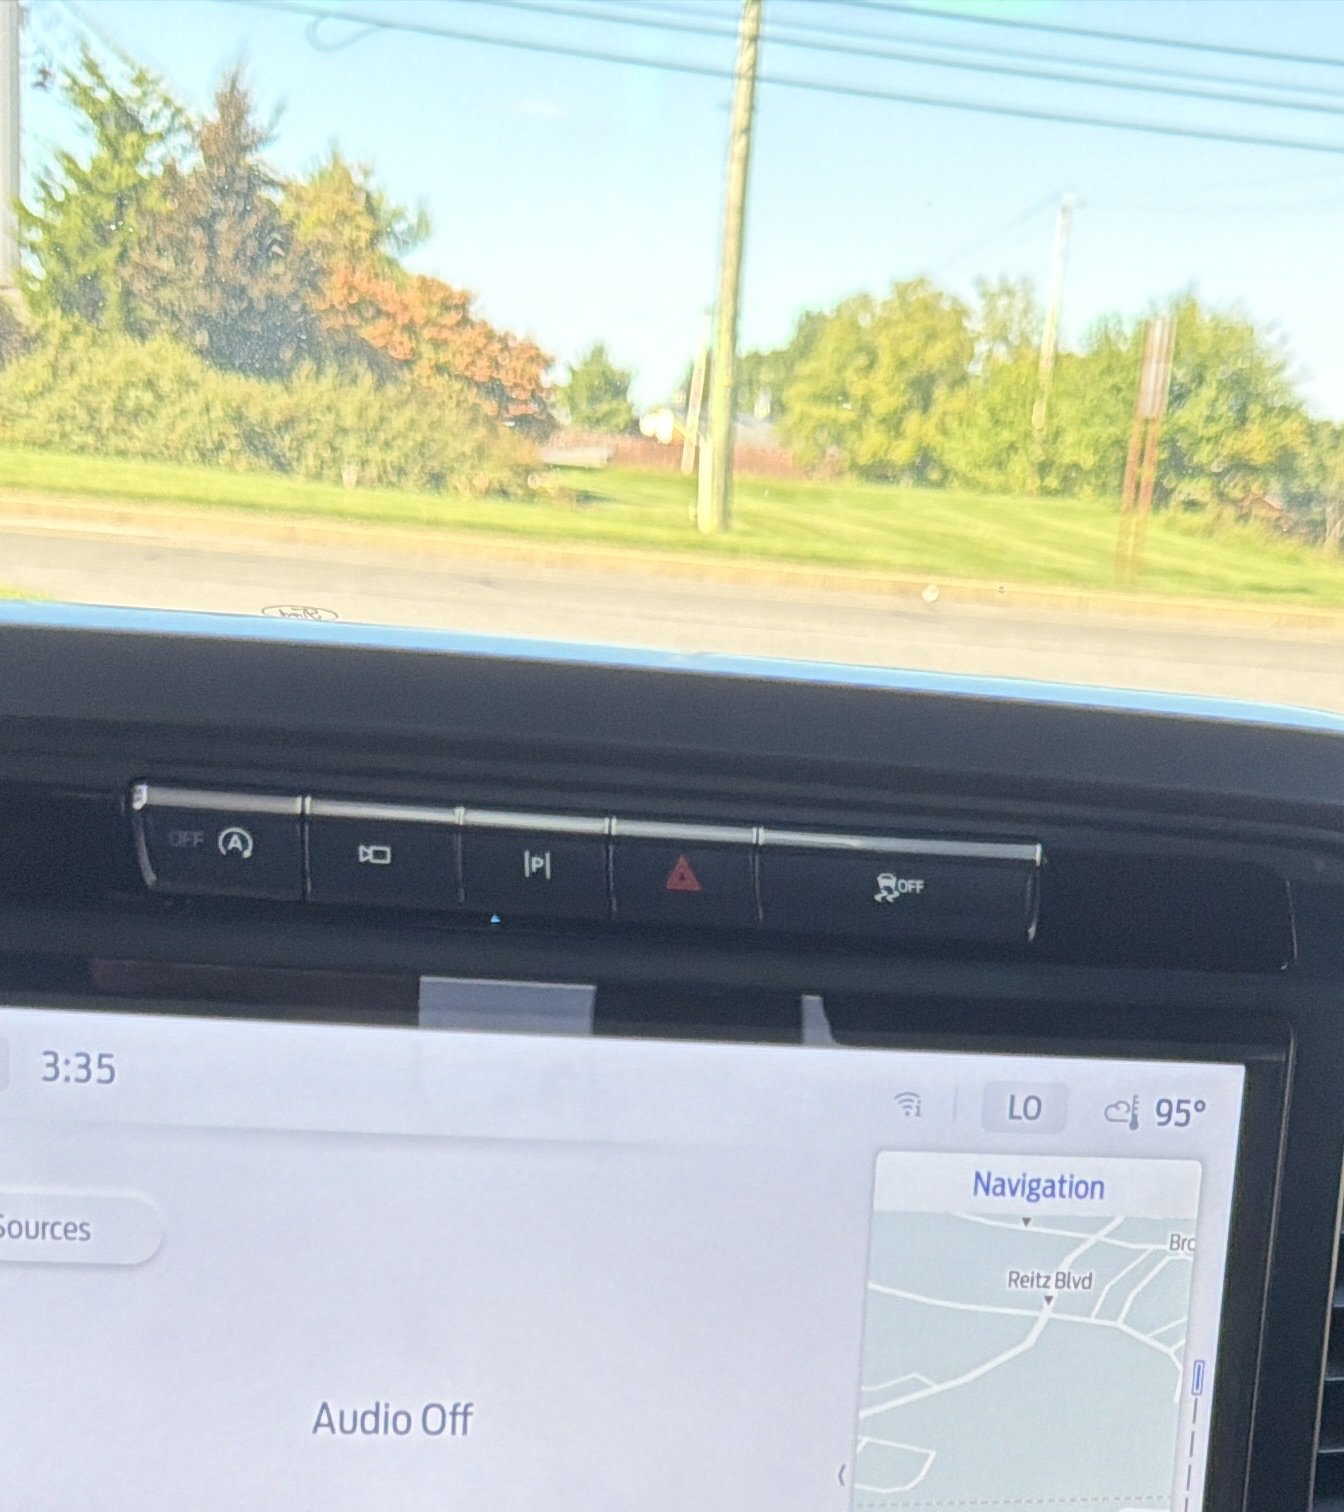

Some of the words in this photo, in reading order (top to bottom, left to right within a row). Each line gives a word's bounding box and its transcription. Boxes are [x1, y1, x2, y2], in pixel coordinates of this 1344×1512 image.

[897, 878, 925, 894] OFF
[40, 1050, 116, 1084] 3:35
[1008, 1093, 1042, 1121] LO
[1155, 1098, 1207, 1127] 95°
[972, 1170, 1105, 1203] Navigation
[1007, 1270, 1052, 1289] Reitz
[1054, 1271, 1093, 1290] Blvd
[311, 1401, 412, 1436] Audio
[420, 1401, 474, 1436] Off
